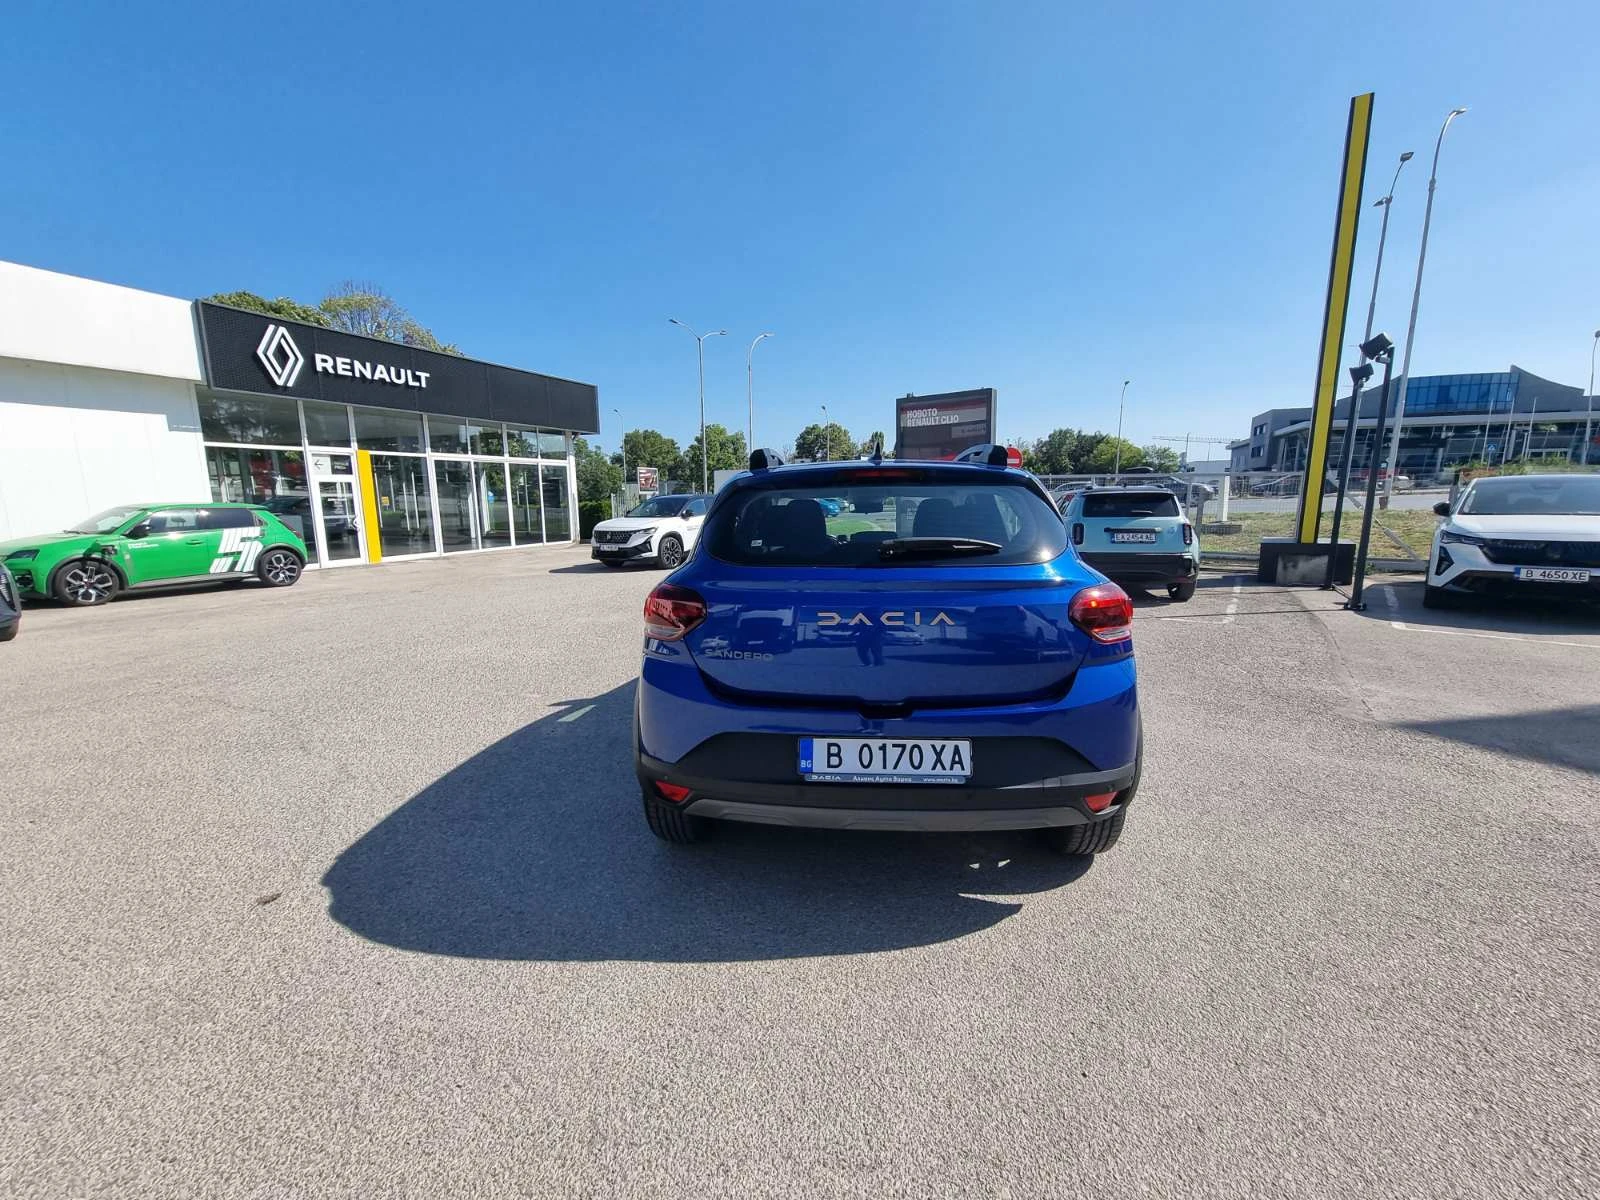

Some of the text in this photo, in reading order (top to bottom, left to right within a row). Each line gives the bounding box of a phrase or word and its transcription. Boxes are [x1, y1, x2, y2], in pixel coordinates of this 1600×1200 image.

[314, 353, 431, 389] RENAULT
[907, 415, 959, 427] RENAULT CLIO
[816, 611, 956, 626] DACIA
[703, 648, 775, 663] SANDERO
[826, 742, 843, 769] B
[800, 759, 813, 768] BG
